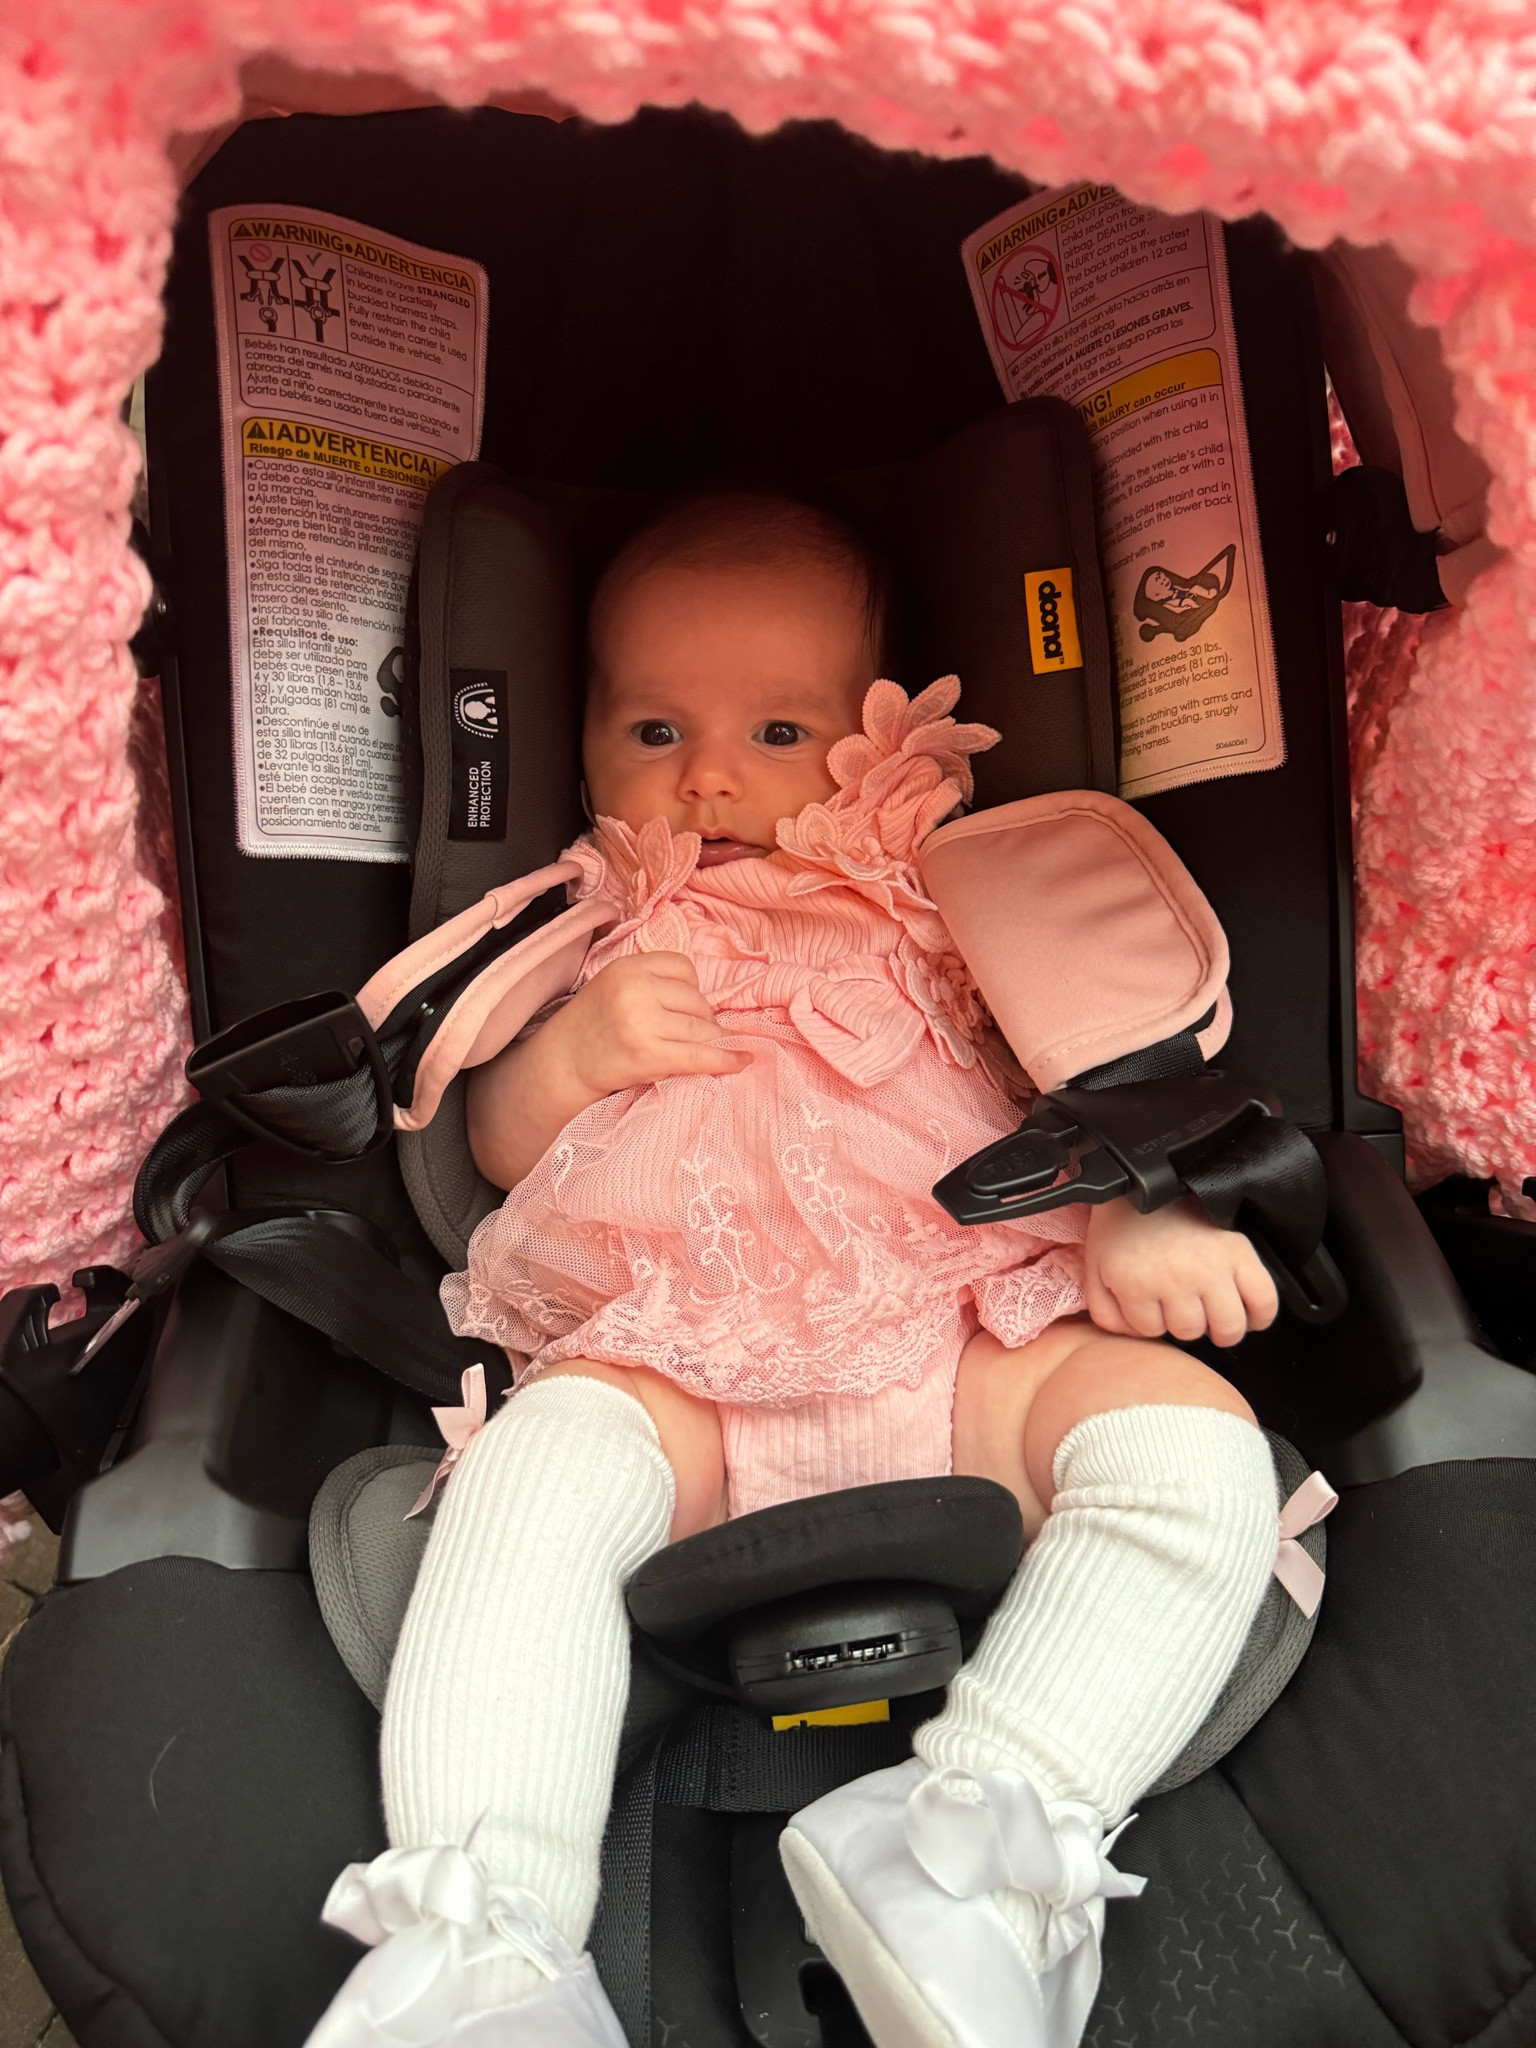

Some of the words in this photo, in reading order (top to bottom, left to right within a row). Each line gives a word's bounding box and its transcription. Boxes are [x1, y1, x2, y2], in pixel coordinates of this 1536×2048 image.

[988, 203, 1058, 250] WARNING
[1064, 250, 1095, 273] INJURY
[1097, 243, 1116, 257] can
[1117, 229, 1150, 248] occur.
[1066, 273, 1082, 286] The
[1083, 258, 1108, 278] back
[1109, 248, 1130, 266] seat
[1132, 246, 1138, 255] is
[1140, 239, 1157, 252] the
[1160, 227, 1190, 245] safest
[345, 262, 387, 283] Children
[390, 275, 414, 291] have
[417, 283, 470, 308] STRANGLED
[346, 275, 355, 286] in
[358, 278, 383, 295] loose
[386, 289, 397, 298] or
[400, 292, 437, 311] partially
[348, 288, 388, 310] buckled
[391, 302, 428, 321] harness
[430, 315, 458, 330] straps.
[349, 301, 370, 319] Fully
[372, 310, 408, 328] restrain
[411, 321, 426, 333] the
[429, 327, 450, 340] child
[1112, 315, 1151, 341] LESIONES
[1152, 301, 1194, 323] GRAVES.
[349, 318, 375, 332] even
[377, 326, 405, 340] when
[407, 334, 437, 350] carrier
[440, 342, 446, 353] is
[447, 347, 467, 361] used
[350, 331, 387, 348] outside
[389, 341, 405, 354] the
[407, 348, 444, 365] vehicle.
[1098, 403, 1131, 428] INJURY
[1133, 394, 1152, 410] can
[1153, 382, 1186, 400] occur
[1110, 417, 1141, 440] position
[1142, 407, 1169, 423] when
[1170, 398, 1198, 413] using
[1200, 395, 1207, 404] it
[1209, 393, 1219, 403] in
[1143, 432, 1162, 450] with
[1164, 428, 1181, 440] this
[1182, 419, 1209, 434] child
[250, 443, 293, 458] Riesgo
[296, 448, 311, 459] de
[313, 451, 361, 471] MUERTE
[364, 465, 371, 473] o
[373, 465, 426, 487] LESIONES
[1151, 452, 1196, 473] vehicle's
[1197, 443, 1224, 458] child
[247, 470, 257, 480] la
[260, 471, 290, 483] debe
[293, 476, 333, 490] colocar
[335, 481, 392, 503] únicamente
[394, 497, 406, 507] en
[254, 460, 300, 474] Cuando
[302, 467, 324, 478] esta
[326, 471, 343, 482] silla
[345, 474, 376, 489] infantil
[258, 483, 268, 492] la
[271, 486, 317, 498] marcha.
[1155, 489, 1194, 510] restraint
[1196, 482, 1219, 497] and
[1220, 482, 1231, 491] in
[1156, 511, 1172, 524] the
[1173, 503, 1202, 517] lower
[1204, 494, 1233, 509] back
[256, 559, 280, 572] Siga
[282, 562, 313, 573] todas
[315, 564, 329, 576] las
[331, 568, 390, 589] instrucciones
[251, 593, 288, 603] trasero
[290, 594, 308, 605] del
[310, 599, 350, 613] asiento.
[252, 615, 269, 625] del
[272, 616, 330, 631] fabricante.
[259, 627, 318, 640] Requisitos
[320, 631, 335, 642] de
[338, 636, 359, 647] uso:
[253, 638, 274, 648] Esta
[276, 639, 296, 649] silla
[298, 641, 332, 653] infantil
[334, 645, 353, 656] sólo
[253, 649, 283, 659] debe
[285, 652, 301, 660] ser
[304, 653, 345, 666] utilizada
[346, 659, 368, 670] para
[1150, 651, 1188, 670] exceeds
[1189, 645, 1201, 657] 30
[1204, 642, 1222, 654] lbs.
[253, 660, 288, 671] bebés
[290, 664, 312, 674] que
[315, 666, 345, 676] pesen
[346, 670, 369, 681] entre
[1154, 675, 1190, 694] securely
[1191, 666, 1229, 682] locked
[1158, 664, 1186, 681] inches
[1189, 658, 1203, 673] (81
[1207, 652, 1233, 666] cm).
[254, 694, 267, 704] 32
[270, 695, 322, 708] pulgadas
[324, 698, 337, 710] (81
[340, 702, 358, 715] cm)
[359, 704, 371, 715] de
[276, 685, 284, 695] y
[286, 686, 309, 696] que
[311, 687, 343, 699] midan
[344, 690, 368, 703] hasta
[1179, 697, 1200, 711] with
[1202, 694, 1228, 706] arms
[1230, 688, 1253, 700] and
[255, 705, 290, 716] altura.
[1161, 714, 1203, 731] buckling,
[1205, 703, 1239, 719] snugly
[262, 716, 330, 729] Descontinúe
[331, 721, 340, 731] el
[342, 724, 357, 734] uso
[358, 725, 370, 736] de
[257, 749, 272, 759] de
[275, 750, 289, 760] 32
[291, 752, 340, 764] pulgadas
[342, 755, 354, 767] (81
[356, 758, 373, 771] cm).
[468, 766, 479, 828] ENHANCED
[480, 760, 492, 828] PROTECTION
